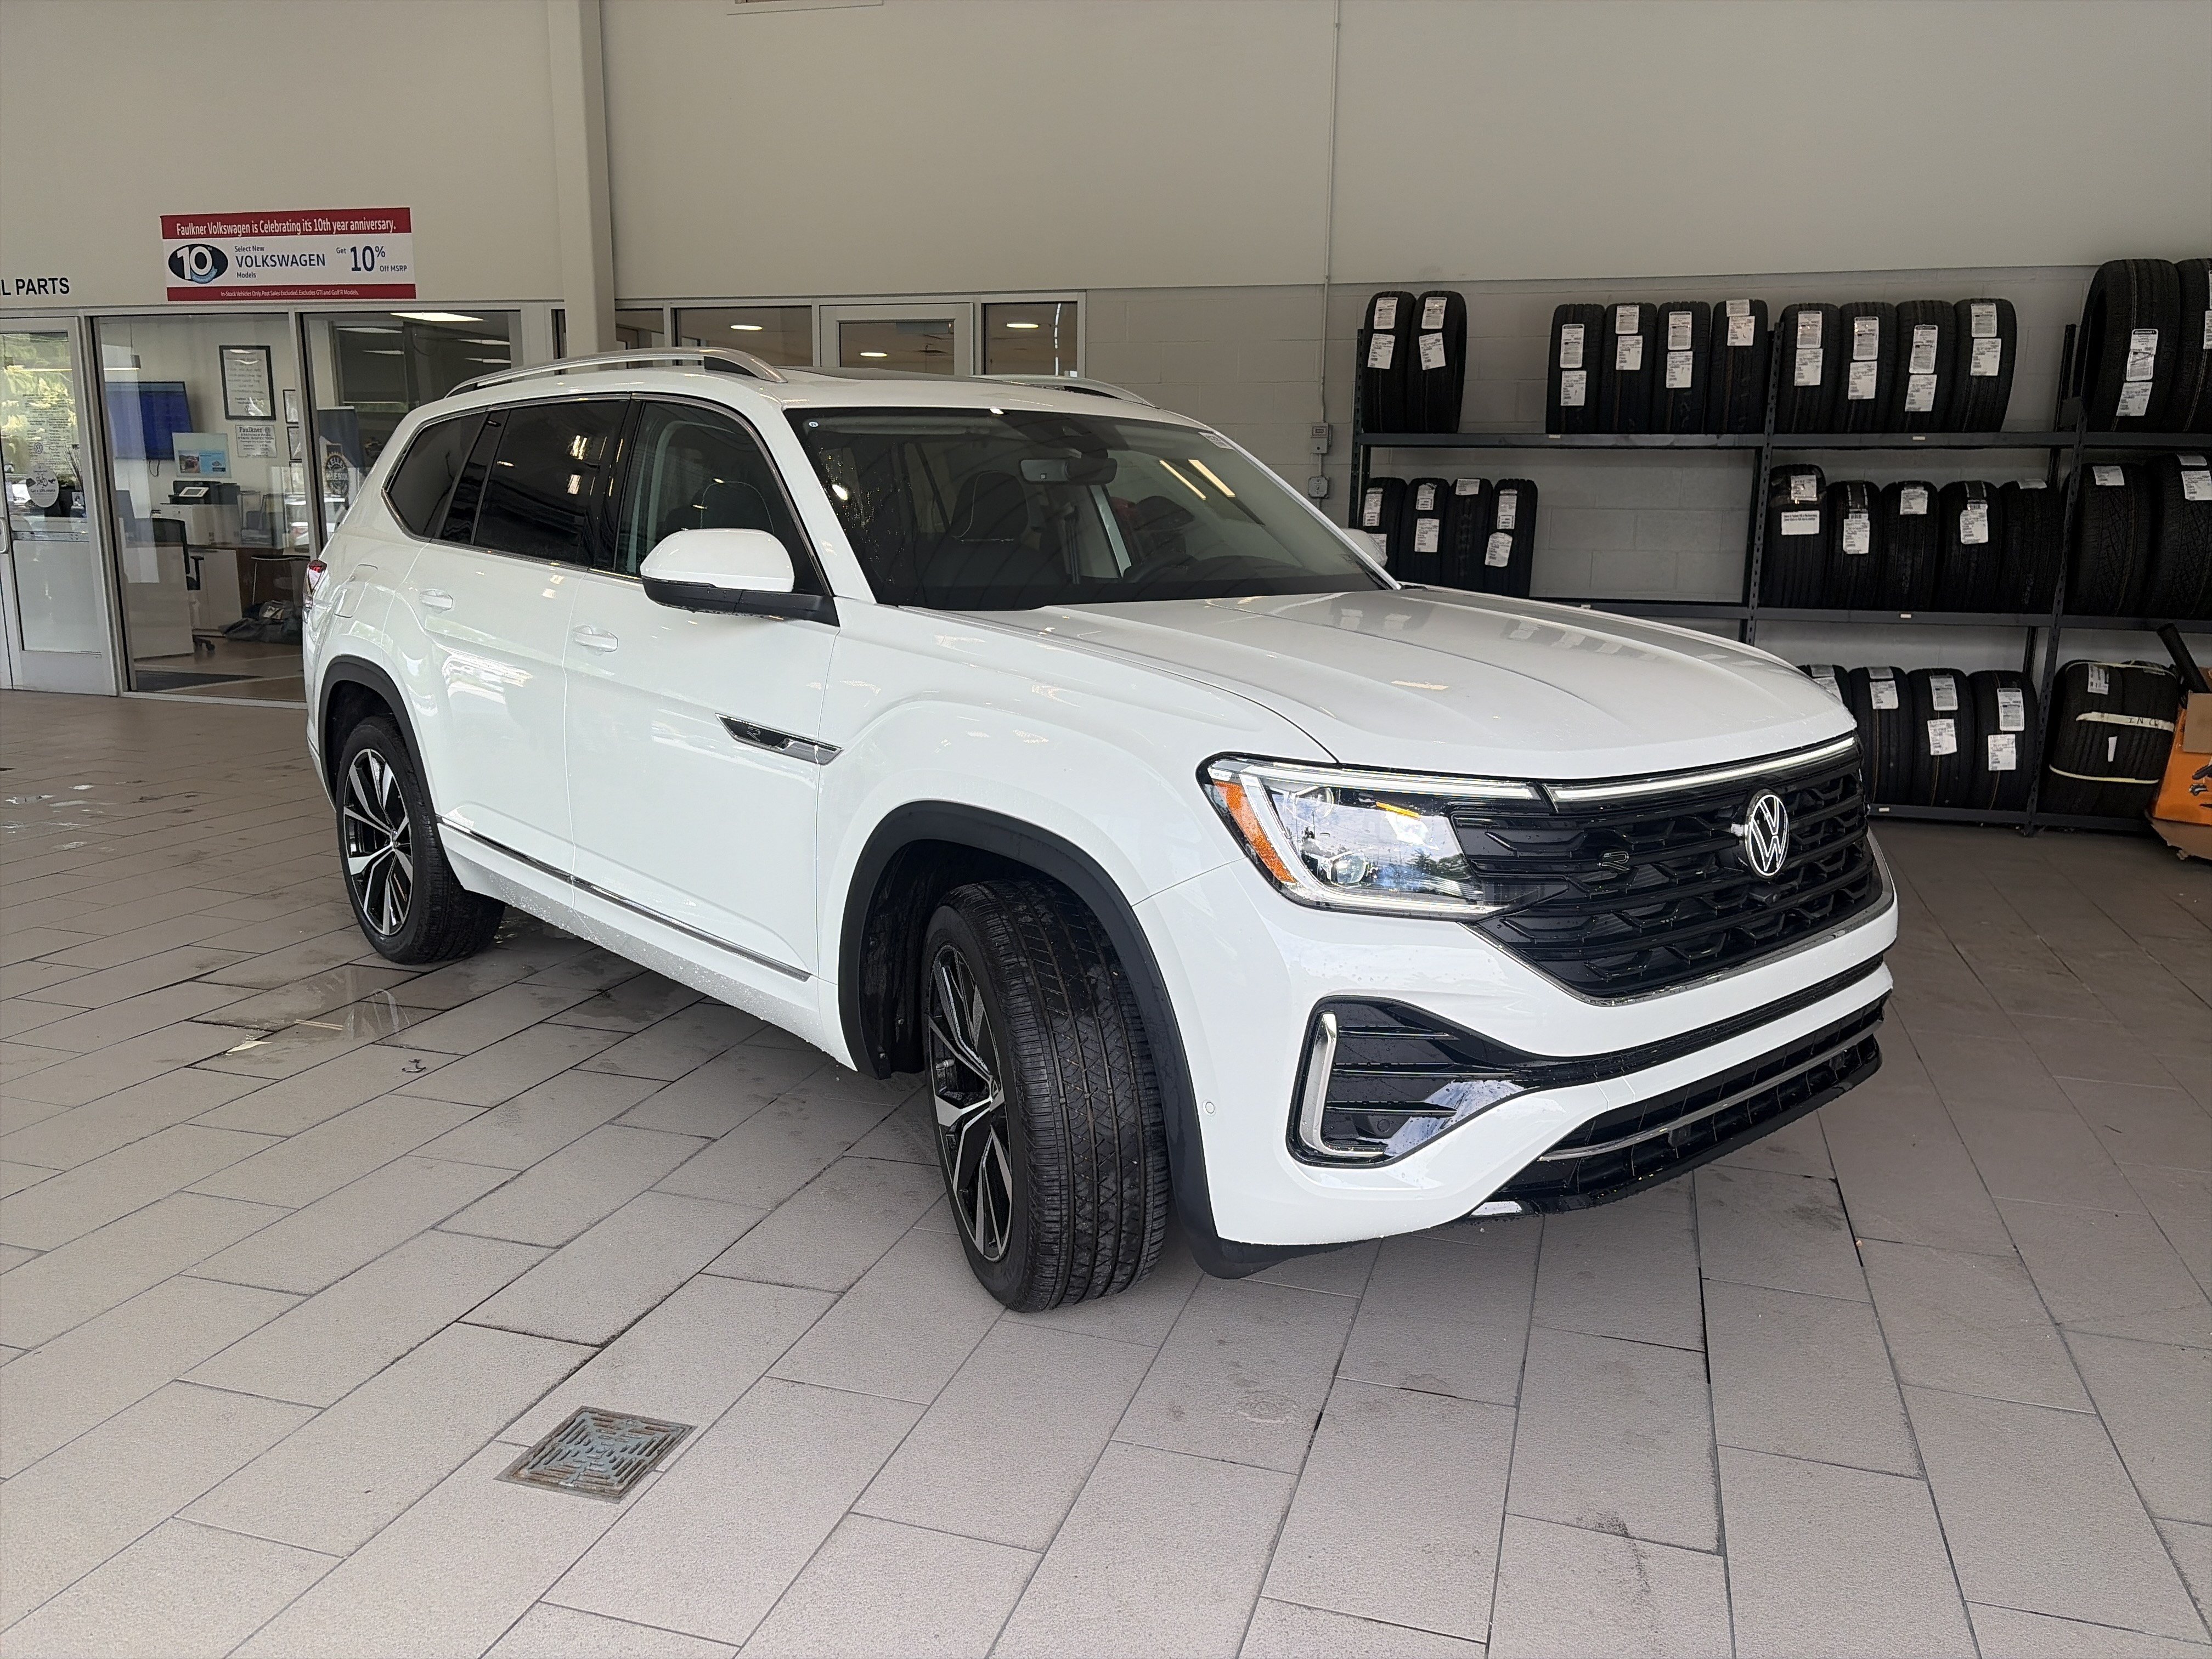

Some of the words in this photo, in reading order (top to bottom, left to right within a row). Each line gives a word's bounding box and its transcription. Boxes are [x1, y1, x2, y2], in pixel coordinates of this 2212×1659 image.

[177, 222, 206, 235] Faulkner
[207, 221, 250, 236] Volkswagen
[252, 221, 258, 233] is
[259, 219, 301, 235] Celebrating
[314, 218, 331, 232] 10th
[332, 220, 348, 234] year
[350, 217, 396, 233] anniversary.
[177, 246, 212, 280] 10
[235, 253, 325, 268] VOLKSWAGEN
[15, 277, 70, 295] PARTS
